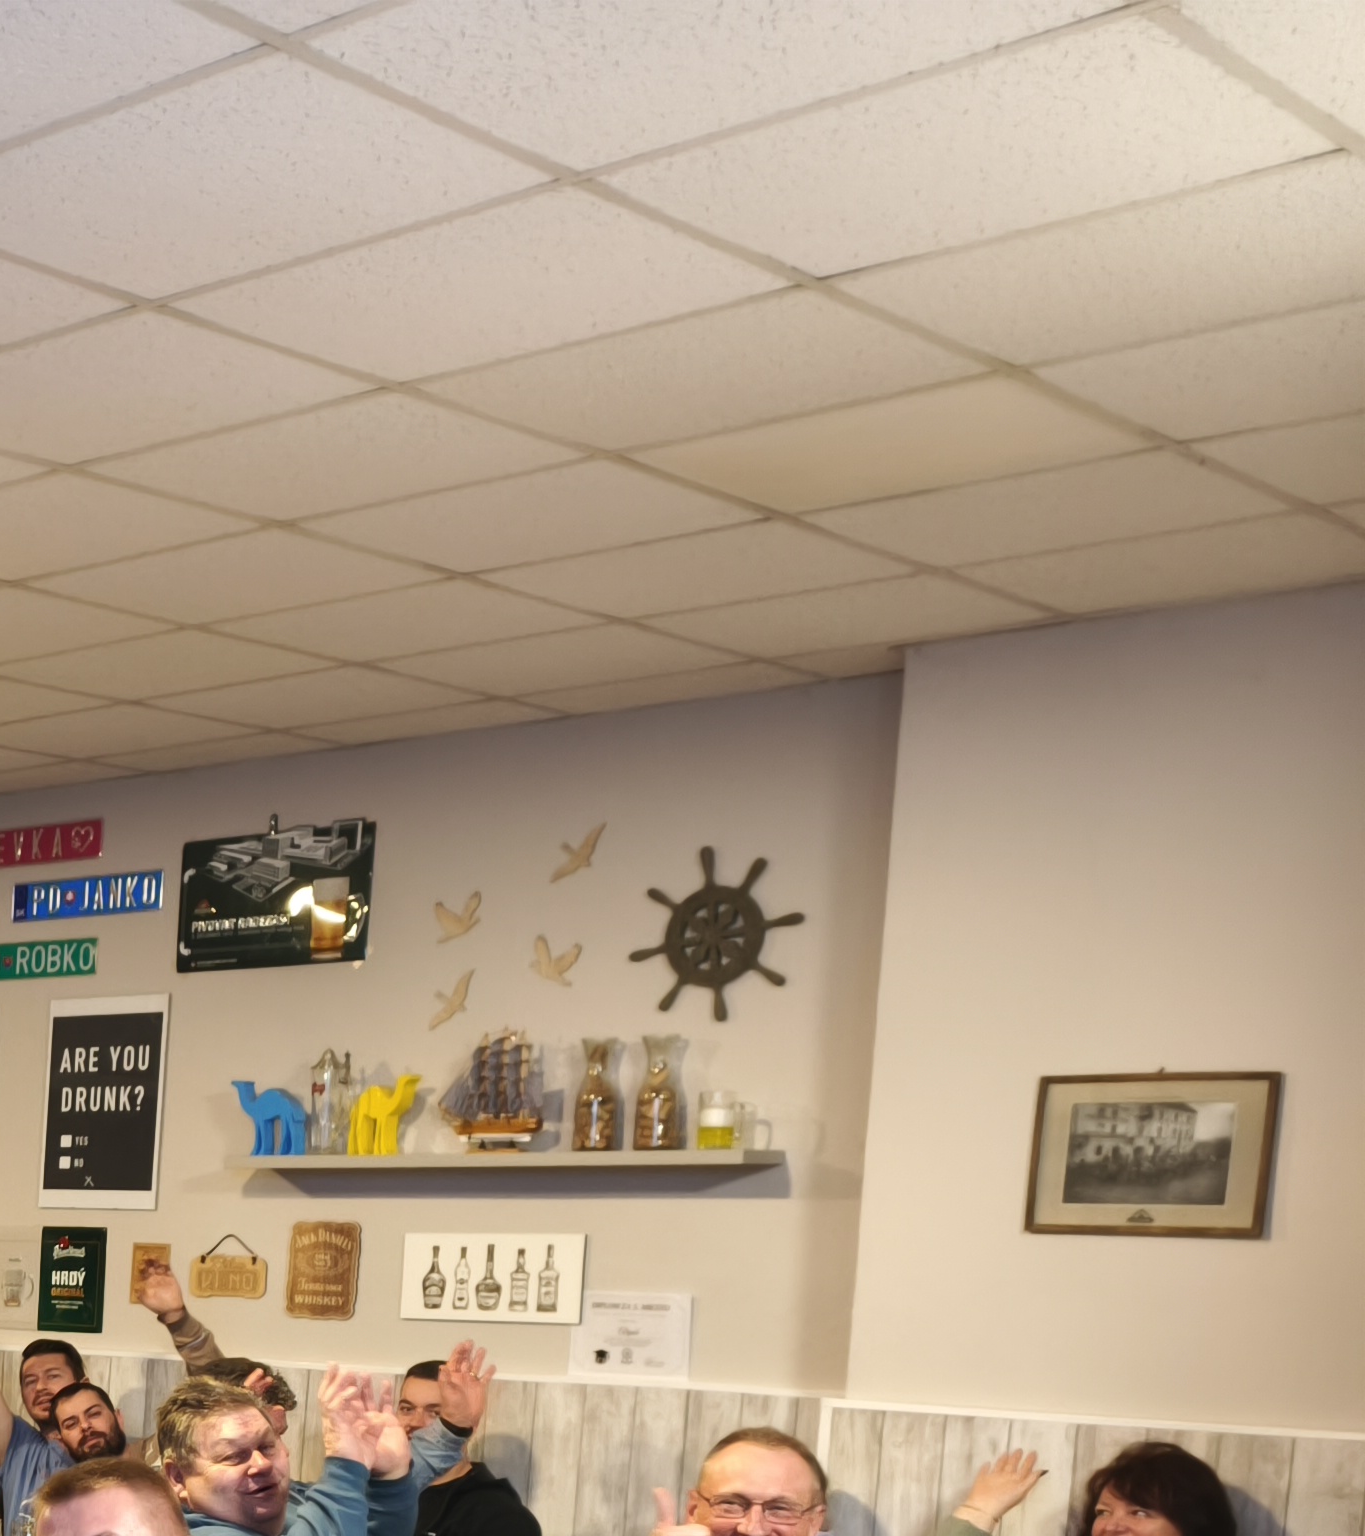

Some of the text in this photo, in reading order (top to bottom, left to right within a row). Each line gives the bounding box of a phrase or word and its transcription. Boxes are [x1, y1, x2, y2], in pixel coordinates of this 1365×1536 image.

[33, 885, 61, 916] PD
[79, 875, 156, 911] JANKO
[16, 943, 94, 975] ROBKO
[59, 1045, 150, 1073] ARE YOU
[61, 1085, 145, 1112] DRUNK?
[75, 1136, 89, 1146] YES
[52, 1267, 86, 1286] HRDÝ
[295, 1294, 345, 1306] WHISKEY
